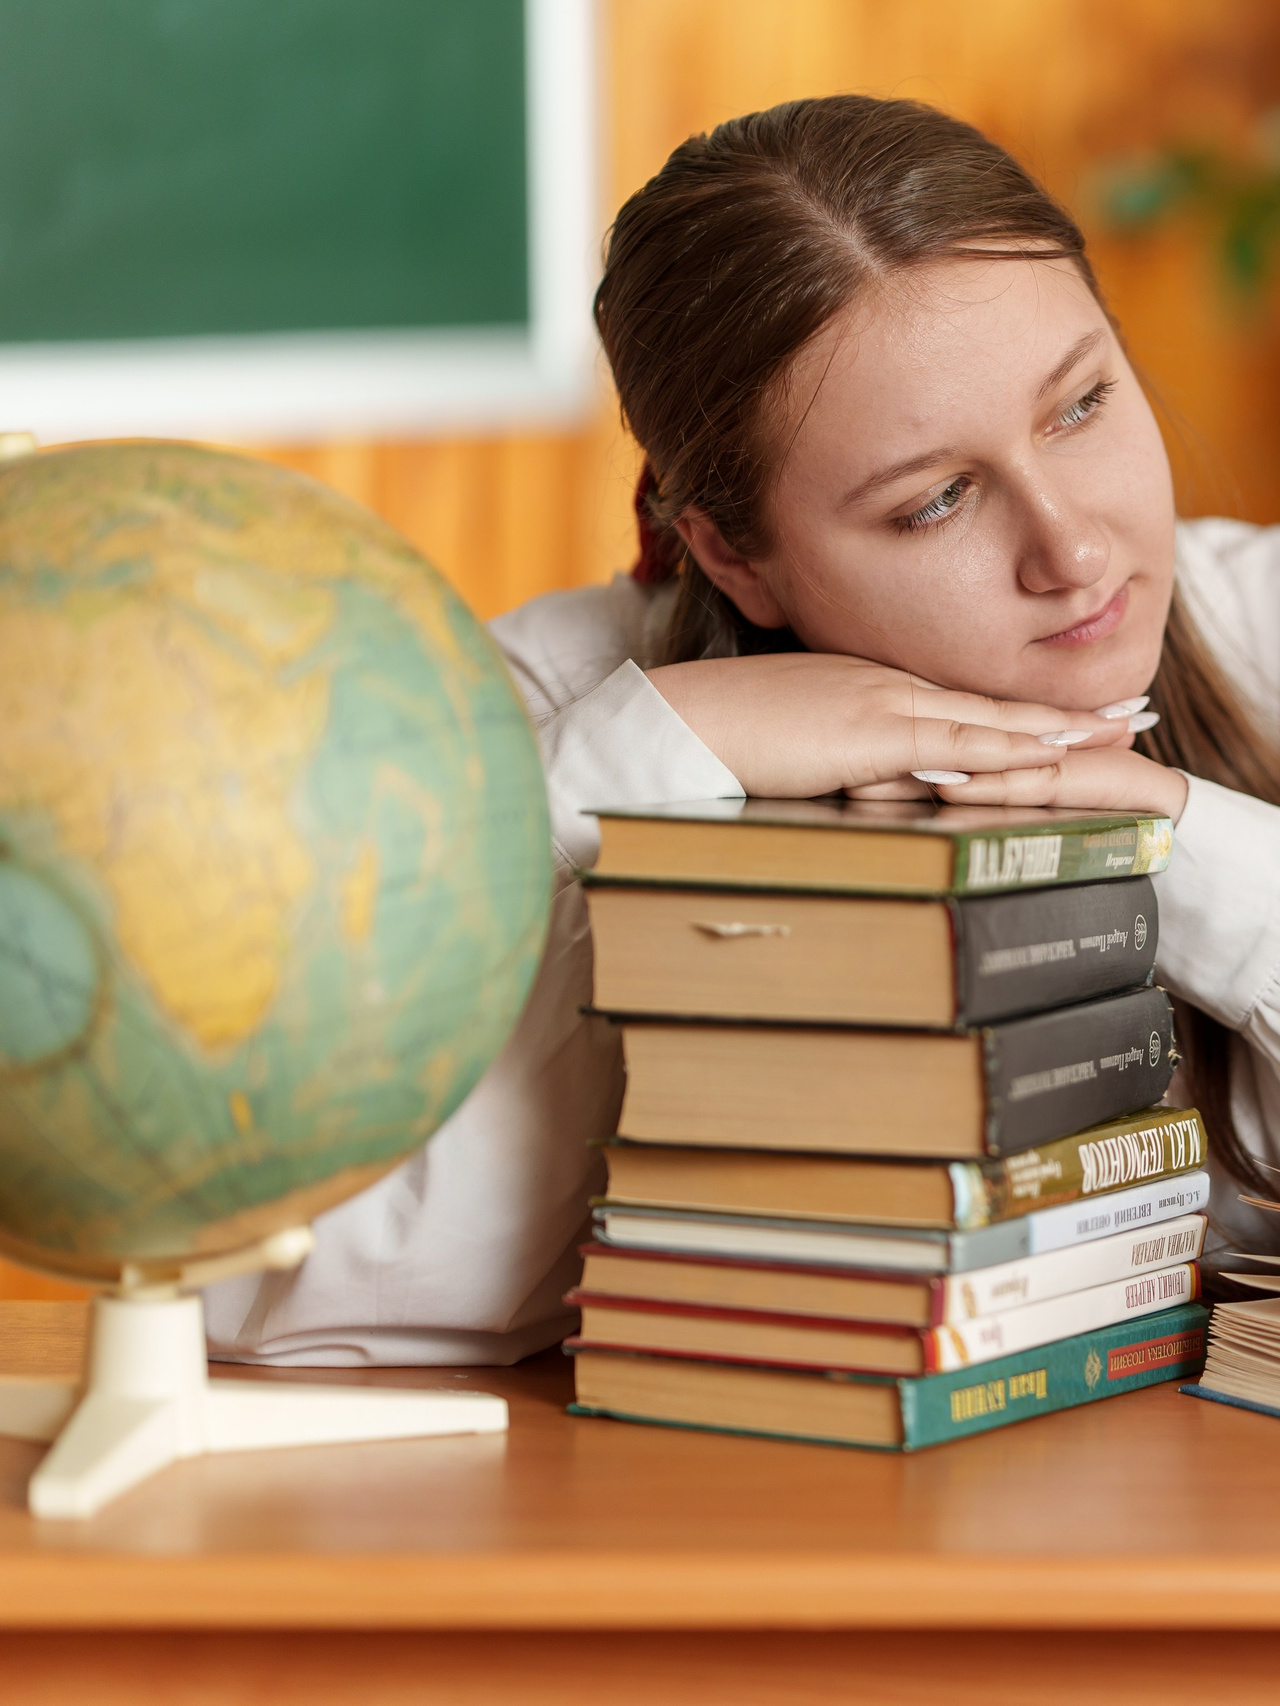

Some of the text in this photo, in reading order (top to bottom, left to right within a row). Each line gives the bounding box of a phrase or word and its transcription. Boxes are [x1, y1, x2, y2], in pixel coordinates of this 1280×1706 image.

[1113, 1202, 1152, 1229] ЕВГЕНИЙ
[1158, 1190, 1185, 1209] Пушкин
[1076, 1213, 1111, 1235] ОНЕГИН
[1130, 1228, 1198, 1268] МАРИНА ЦВЕТАЕВА
[1125, 1270, 1186, 1310] ЛЕОНИД АНДРЕЕВ
[1110, 1333, 1202, 1372] БИБЛИОТЕКА ПОЭЗИИ
